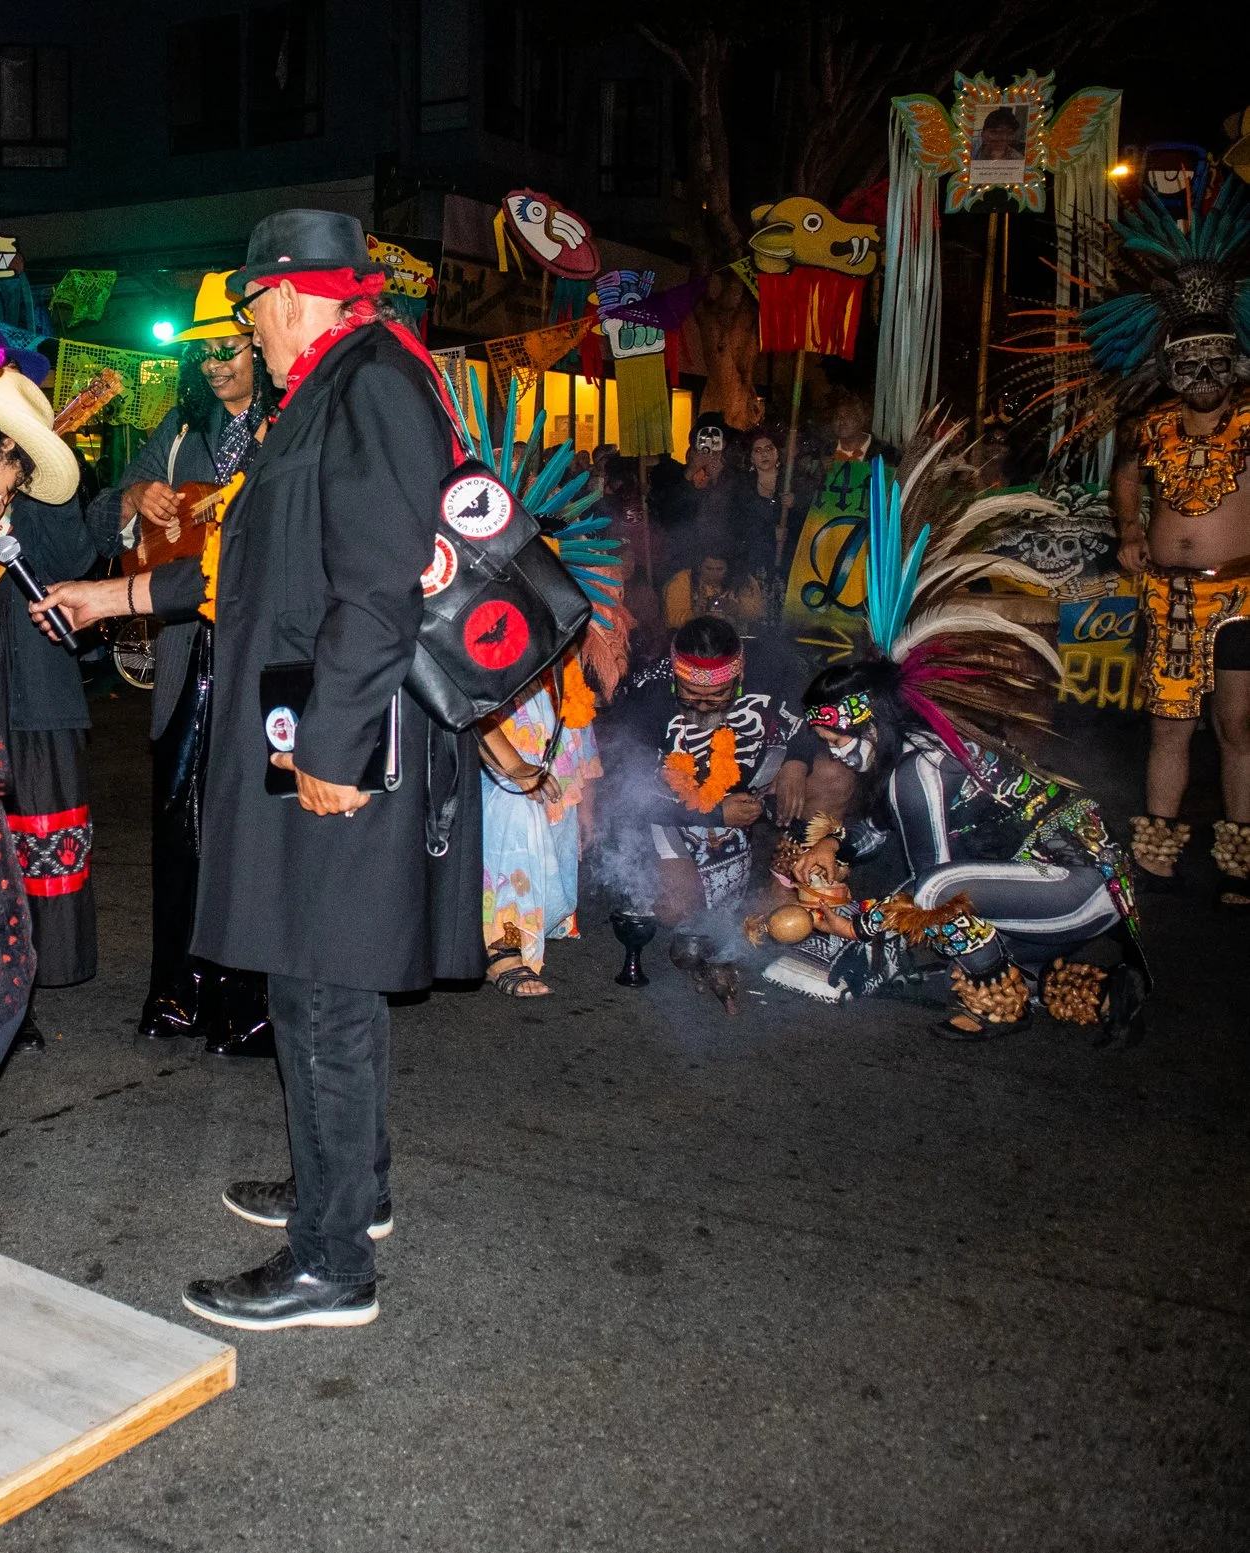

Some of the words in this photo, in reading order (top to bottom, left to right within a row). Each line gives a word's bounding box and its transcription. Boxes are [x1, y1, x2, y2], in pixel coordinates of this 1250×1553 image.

[448, 485, 463, 503] FARM
[466, 479, 504, 498] WORKERS
[447, 505, 468, 531] UNITED
[1073, 599, 1140, 641] los
